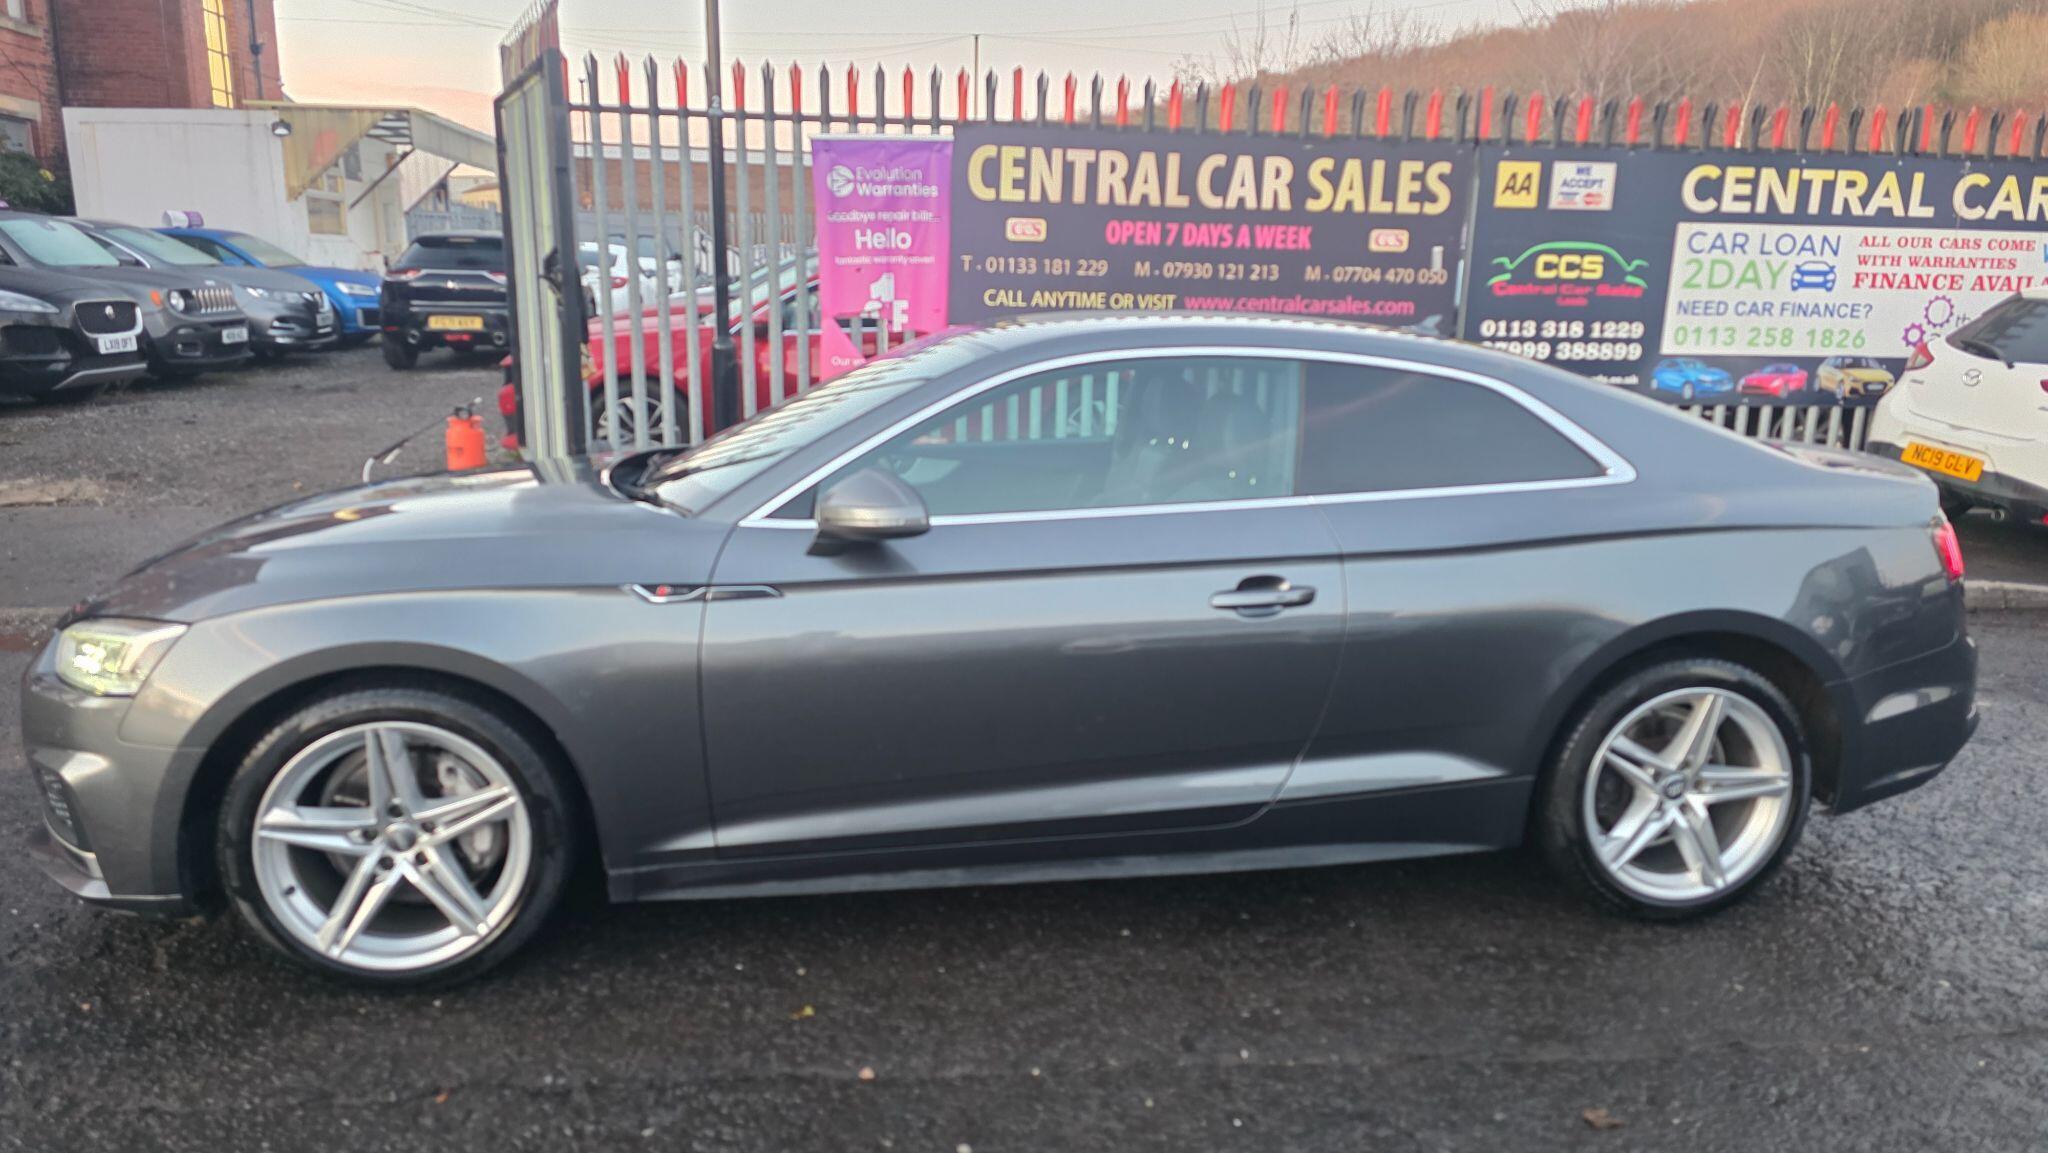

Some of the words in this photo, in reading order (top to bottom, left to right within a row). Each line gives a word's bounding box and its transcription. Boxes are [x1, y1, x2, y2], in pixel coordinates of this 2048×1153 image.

[856, 166, 923, 181] Evolution
[967, 144, 1190, 208] CENTRAL
[1196, 153, 1294, 212] CAR
[1305, 157, 1453, 216] SALES
[1501, 172, 1533, 196] AA
[856, 182, 939, 198] Warranties
[1681, 164, 1935, 218] CENTRAL
[1952, 172, 2048, 222] CAR
[855, 227, 913, 250] Hello
[1105, 220, 1163, 247] OPEN
[1166, 222, 1180, 247] 7
[1182, 223, 1233, 249] DAYS
[1235, 225, 1251, 249] A
[1253, 225, 1313, 251] WEEK
[1687, 231, 1749, 256] CAR
[1761, 233, 1842, 258] LOAN
[1858, 235, 1891, 248] ALL
[1897, 236, 1933, 249] OUR
[1939, 237, 1982, 250] CARS
[1987, 238, 2037, 251] COME
[985, 256, 1037, 275] 01133
[1044, 258, 1071, 275] 181
[1076, 259, 1109, 277] 229
[1134, 261, 1151, 278] M
[1162, 261, 1213, 280] 07930
[1218, 263, 1244, 280] 121
[1249, 264, 1280, 281] 213
[1304, 265, 1321, 282] M
[1332, 265, 1381, 284] 07704
[1385, 267, 1415, 284] 470
[1417, 268, 1448, 285] 050
[1534, 253, 1604, 280] CCS
[1856, 254, 1902, 267] WITH
[1908, 256, 2018, 270] WARRANTIES
[1682, 258, 1788, 291] 2DAY
[1852, 272, 1964, 291] FINANCE
[983, 288, 1027, 307] CALL
[1030, 290, 1107, 309] ANYTIME
[1109, 292, 1134, 310] OR
[1137, 294, 1177, 311] VISIT
[1183, 294, 1415, 316] www.centralcarsales.com
[1676, 300, 1728, 317] NEED
[1734, 301, 1774, 318] CAR
[1780, 302, 1873, 319] FINANCE?
[1479, 319, 1537, 338] 0113
[1540, 320, 1584, 339] 318
[1589, 321, 1645, 340] 1229
[1674, 325, 1736, 347] 0113
[1747, 326, 1794, 348] 258
[1807, 328, 1866, 349] 1826
[1911, 445, 1944, 467] NC19
